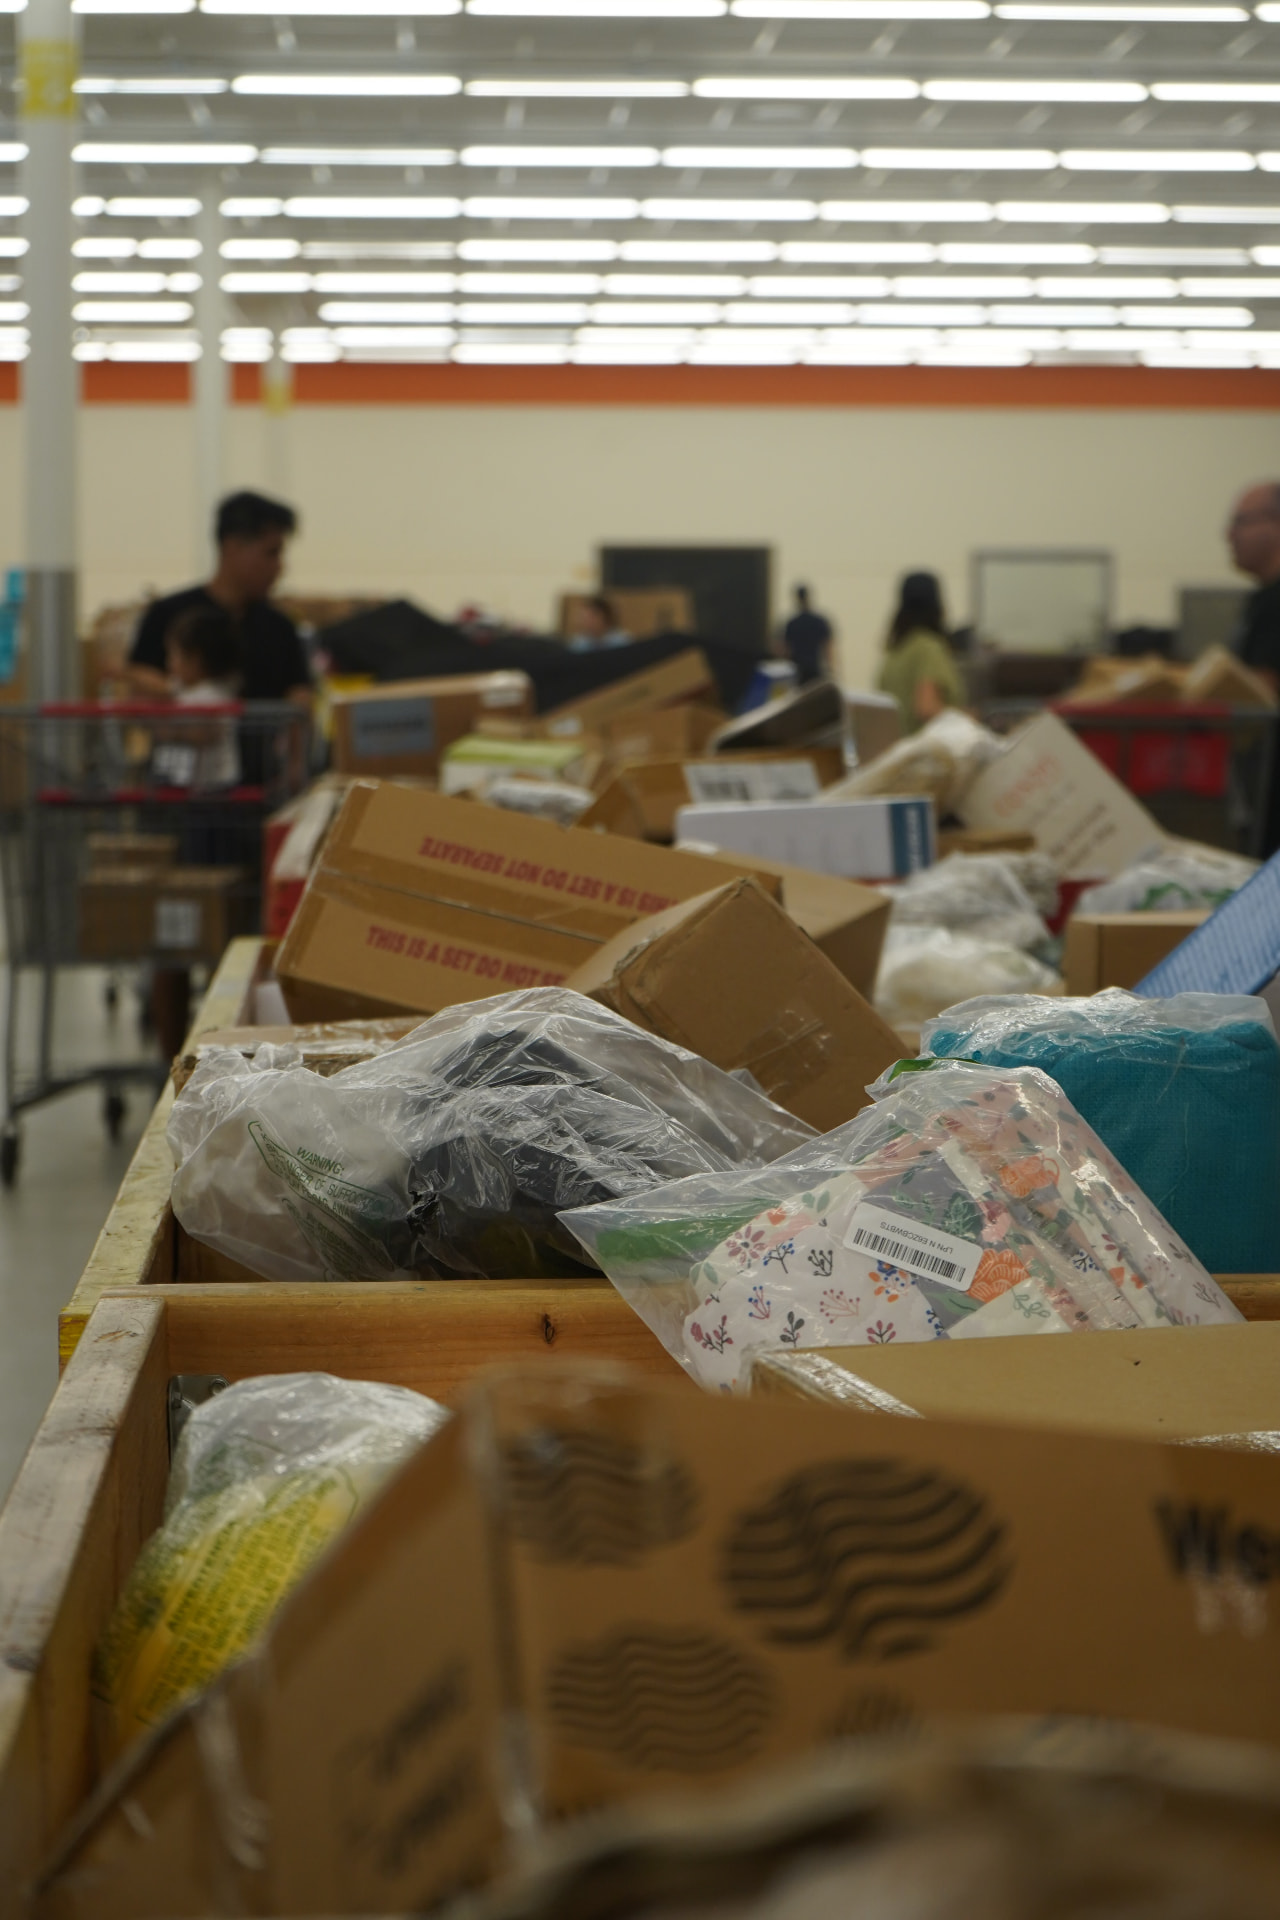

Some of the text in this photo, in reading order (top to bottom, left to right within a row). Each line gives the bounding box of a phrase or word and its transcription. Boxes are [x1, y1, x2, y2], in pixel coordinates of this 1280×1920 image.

[418, 836, 504, 874] SEPARATE
[502, 859, 544, 884] NOT
[540, 867, 571, 892] DO
[566, 873, 602, 900] SET
[602, 882, 620, 904] A
[616, 884, 641, 908] IS
[365, 924, 408, 954] THIS
[404, 936, 429, 960] IS
[425, 940, 441, 963] A
[440, 944, 477, 973] SET
[475, 952, 501, 980] DO
[501, 960, 542, 987] NOT
[296, 1146, 345, 1175] WARNING:
[314, 1178, 326, 1191] OF
[928, 1240, 937, 1250] N
[937, 1243, 953, 1254] LPN
